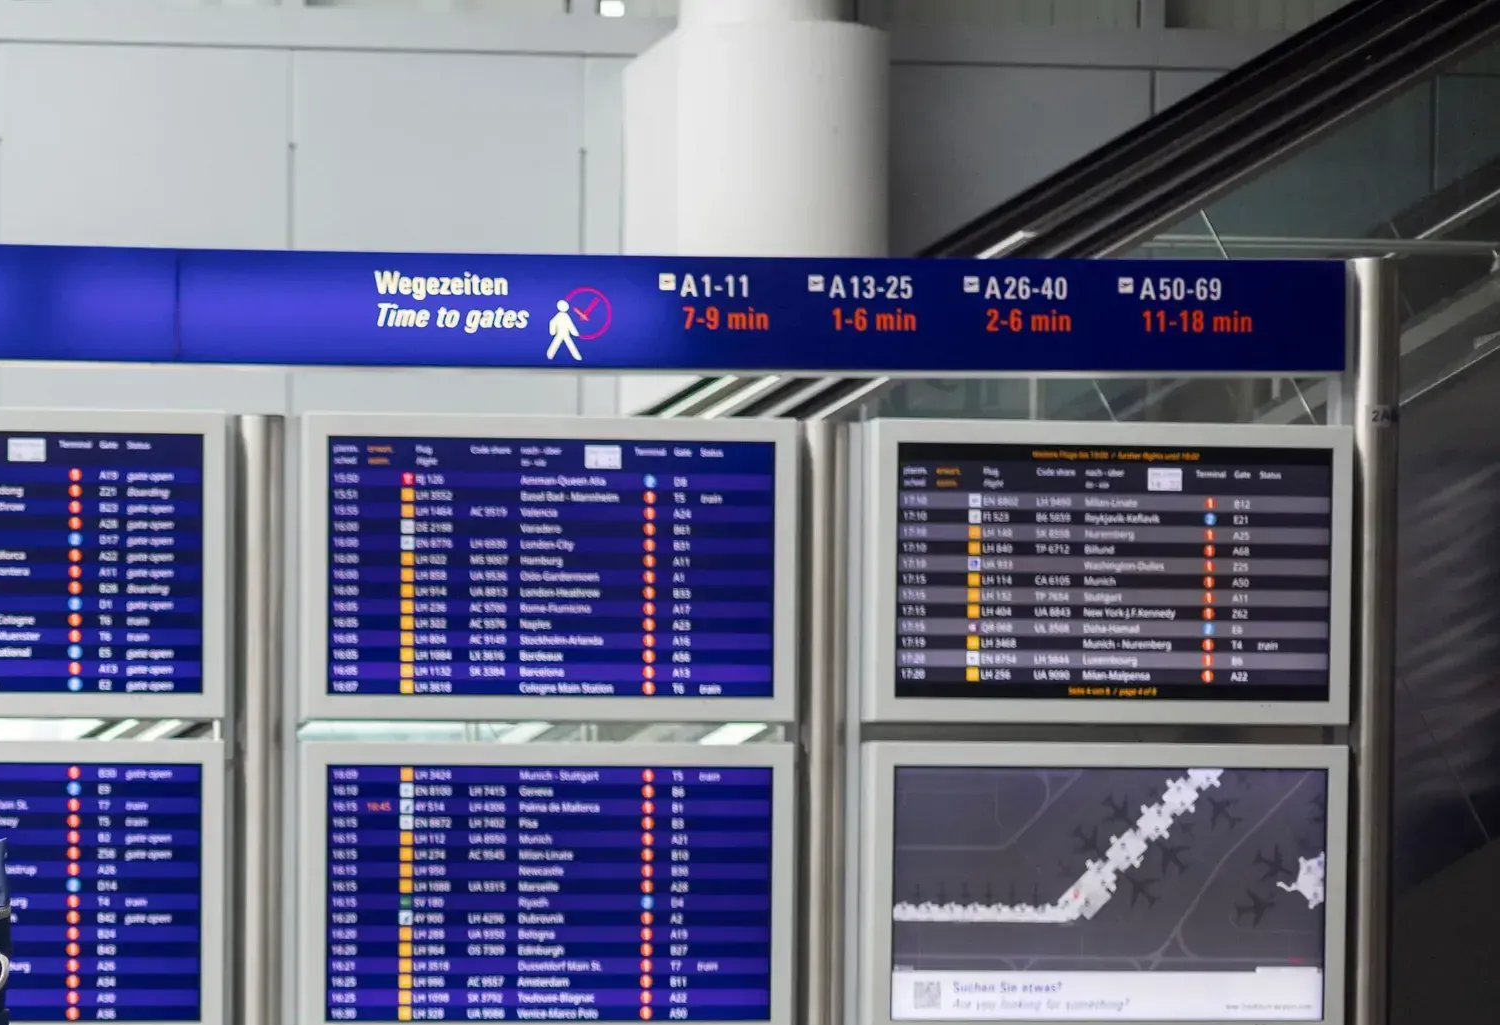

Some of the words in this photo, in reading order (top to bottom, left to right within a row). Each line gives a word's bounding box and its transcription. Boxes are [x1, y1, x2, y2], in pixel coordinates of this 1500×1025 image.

[374, 271, 508, 300] Wegezeiten
[377, 303, 430, 327] Time
[437, 307, 460, 328] to
[464, 307, 529, 333] gates
[683, 306, 719, 330] 7-9
[728, 307, 768, 330] min
[833, 308, 867, 331] 1-6
[876, 308, 916, 330] min
[987, 308, 1022, 332] 2-6
[1031, 310, 1071, 332] min
[1143, 310, 1204, 332] 11-18
[1213, 310, 1252, 332] min
[1196, 470, 1226, 478] Terminal
[1234, 470, 1251, 479] Gate
[1260, 471, 1281, 479] Status
[1084, 576, 1116, 586] Munich
[1083, 639, 1115, 649] Munich
[1121, 640, 1173, 653] Nuremberg
[1258, 642, 1278, 650] train
[126, 665, 150, 676] gate
[148, 666, 174, 676] open
[519, 802, 547, 812] Palma
[560, 802, 600, 813] Mallorca
[519, 818, 538, 828] Pisa
[519, 834, 552, 844] Munich
